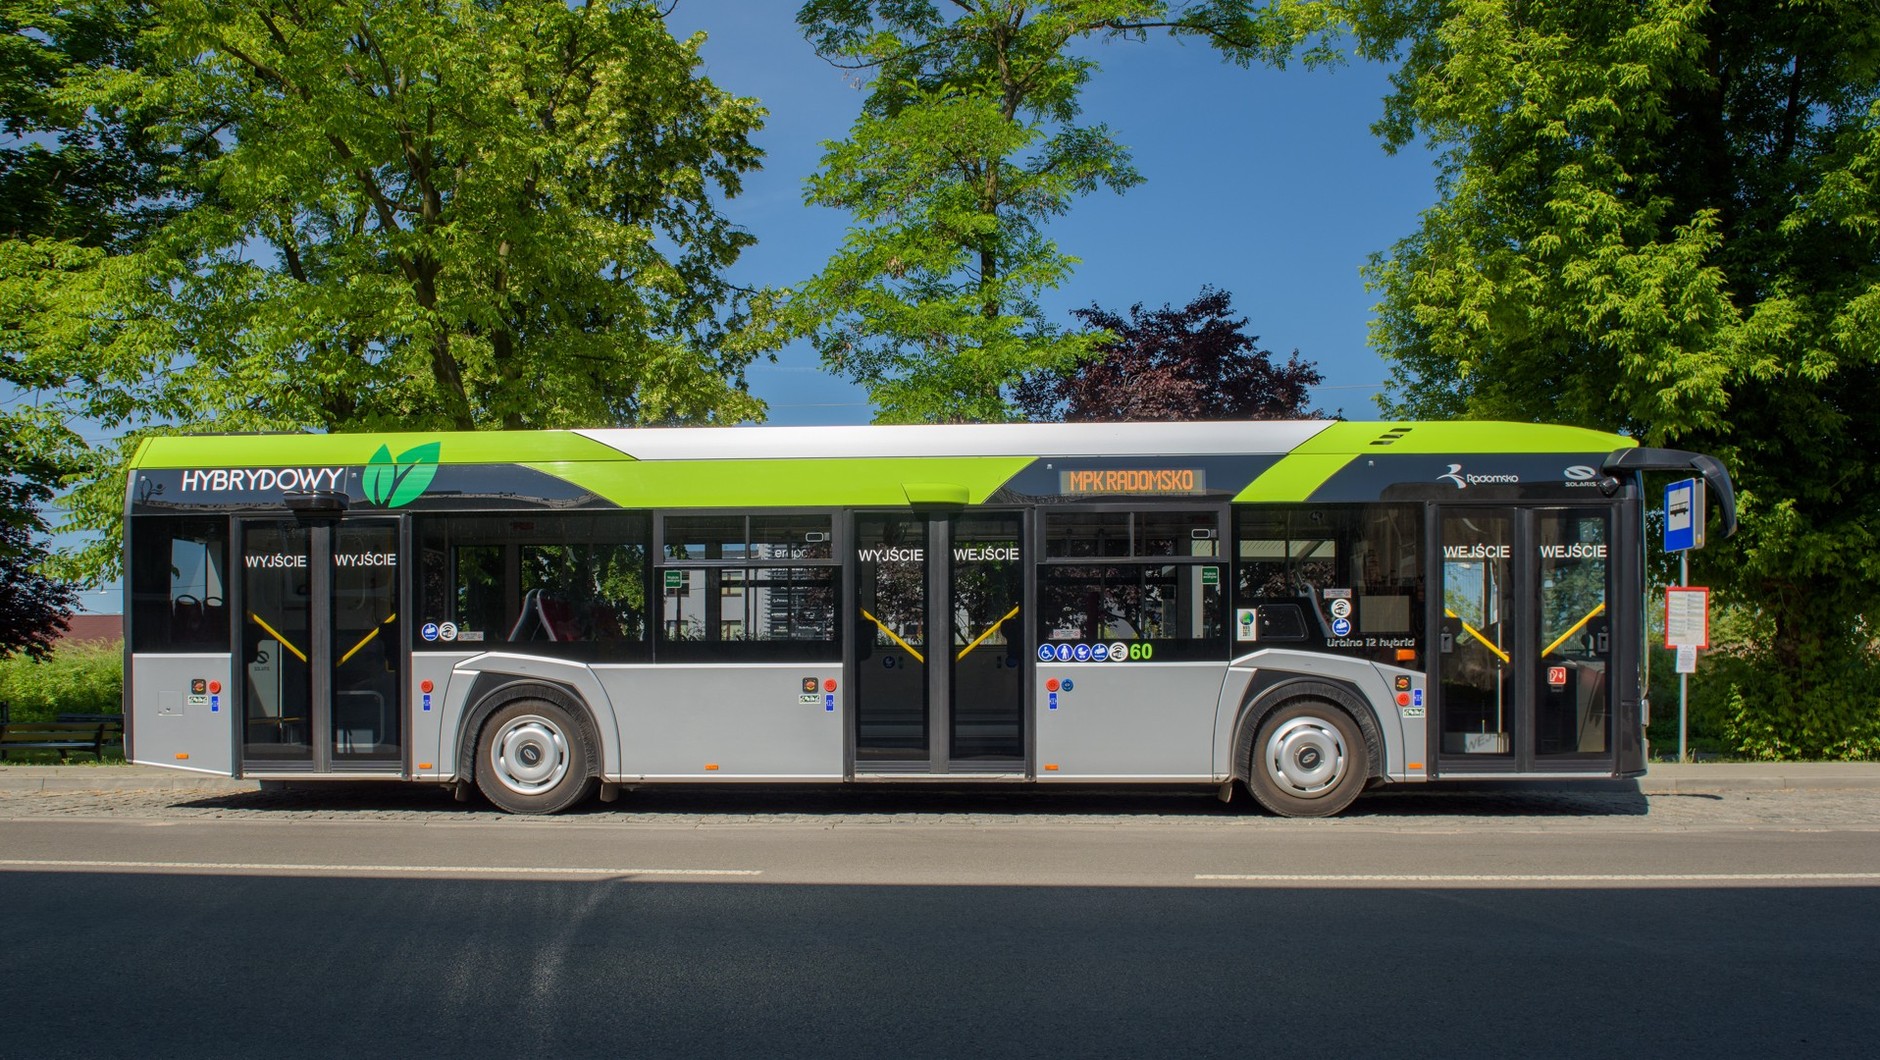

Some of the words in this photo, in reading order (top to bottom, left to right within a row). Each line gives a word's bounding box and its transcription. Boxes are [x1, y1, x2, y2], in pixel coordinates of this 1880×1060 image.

[181, 468, 344, 491] HYBRYDOWY
[1070, 470, 1105, 491] MPK
[1106, 470, 1194, 491] RADOMSKO
[1466, 474, 1519, 486] Radomsko
[858, 547, 924, 562] WYJŚCIE
[953, 545, 1020, 561] WEJŚCIE
[1443, 543, 1511, 559] WEJŚCIE
[1539, 542, 1608, 558] WEJŚCIE
[245, 553, 307, 568] WYJŚCIE
[334, 551, 397, 567] WYJŚCIE
[1326, 638, 1363, 647] Urbino
[1365, 638, 1377, 647] 12
[1379, 637, 1416, 648] hybrid
[1129, 643, 1153, 660] 60
